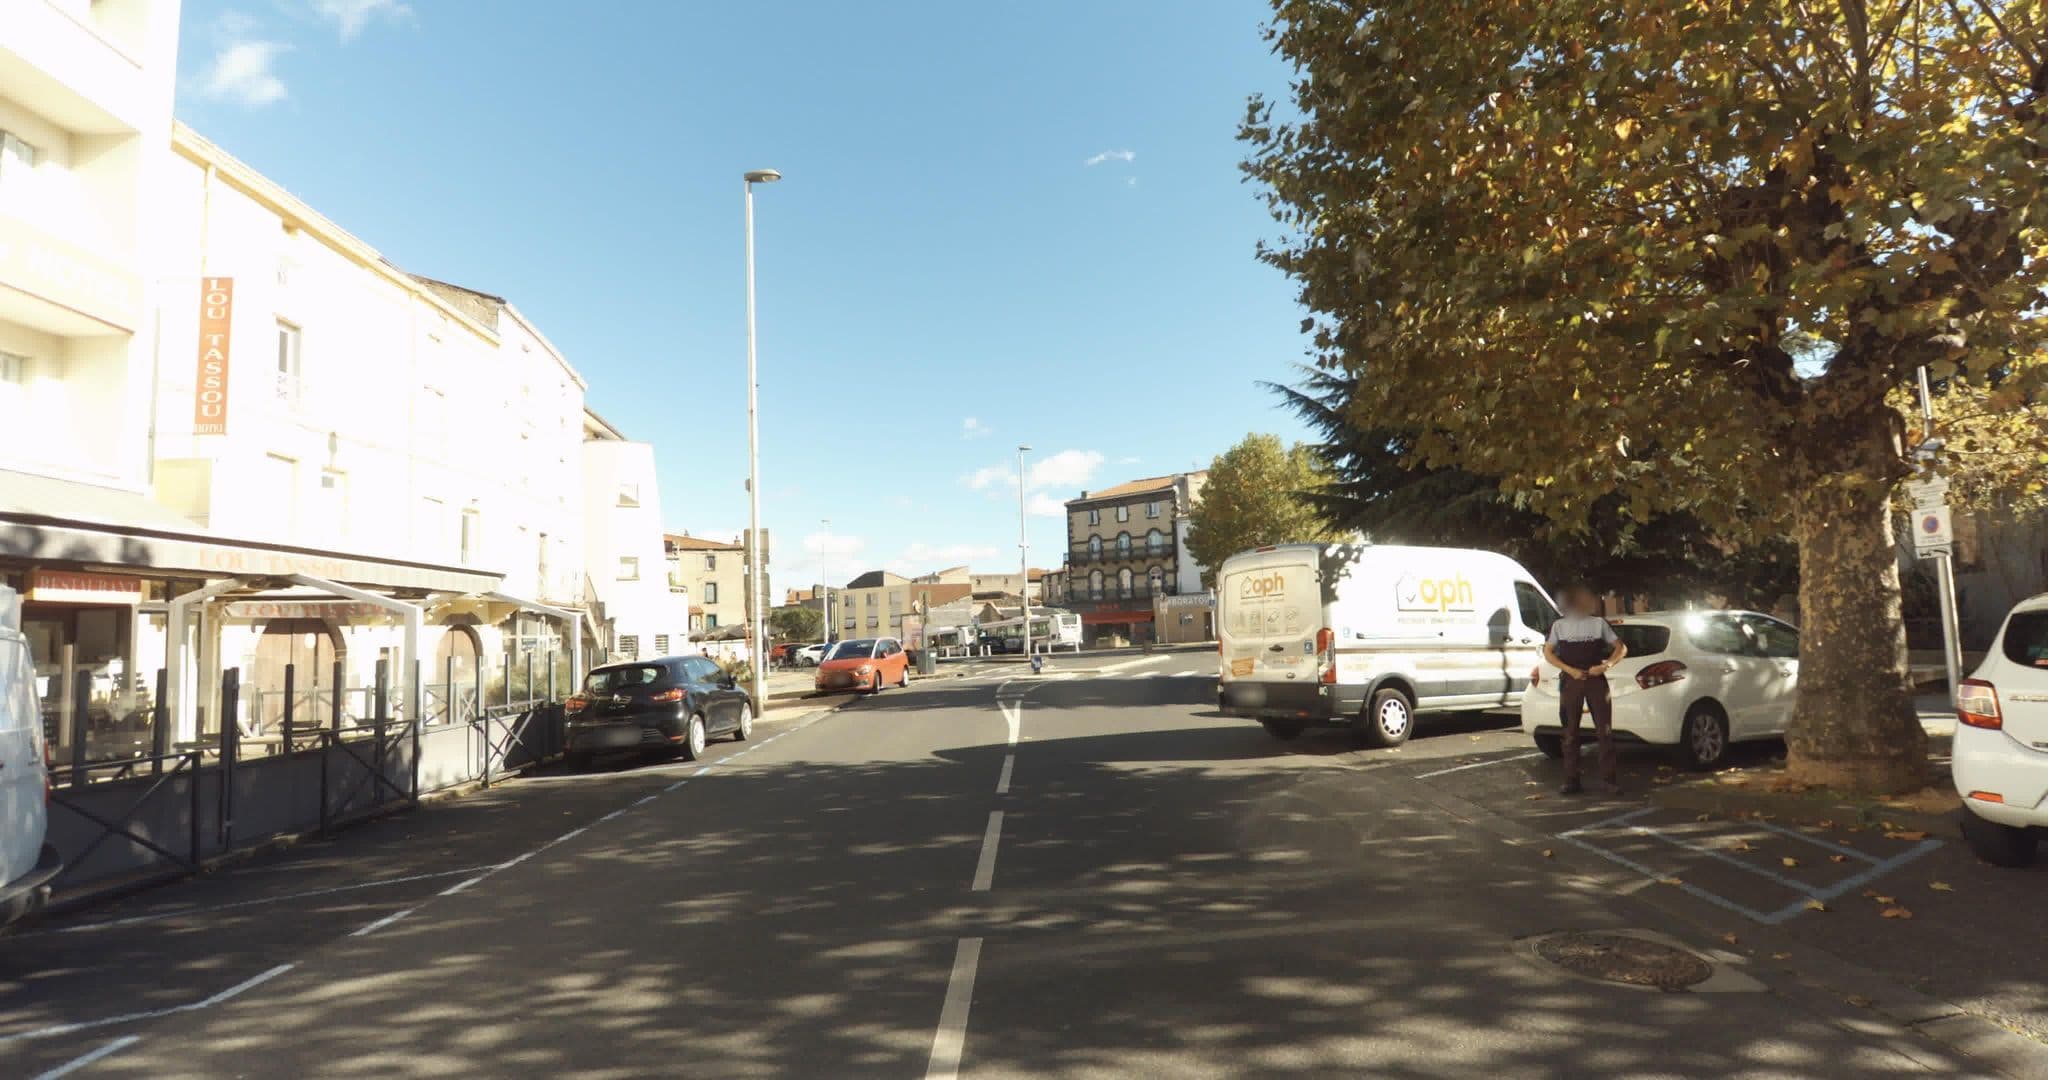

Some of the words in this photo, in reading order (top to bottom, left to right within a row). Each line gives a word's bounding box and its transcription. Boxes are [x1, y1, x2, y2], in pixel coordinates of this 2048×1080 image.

[206, 280, 228, 320] LOU
[200, 334, 225, 417] TASSOU
[1252, 572, 1284, 597] oph
[1419, 569, 1473, 612] oph
